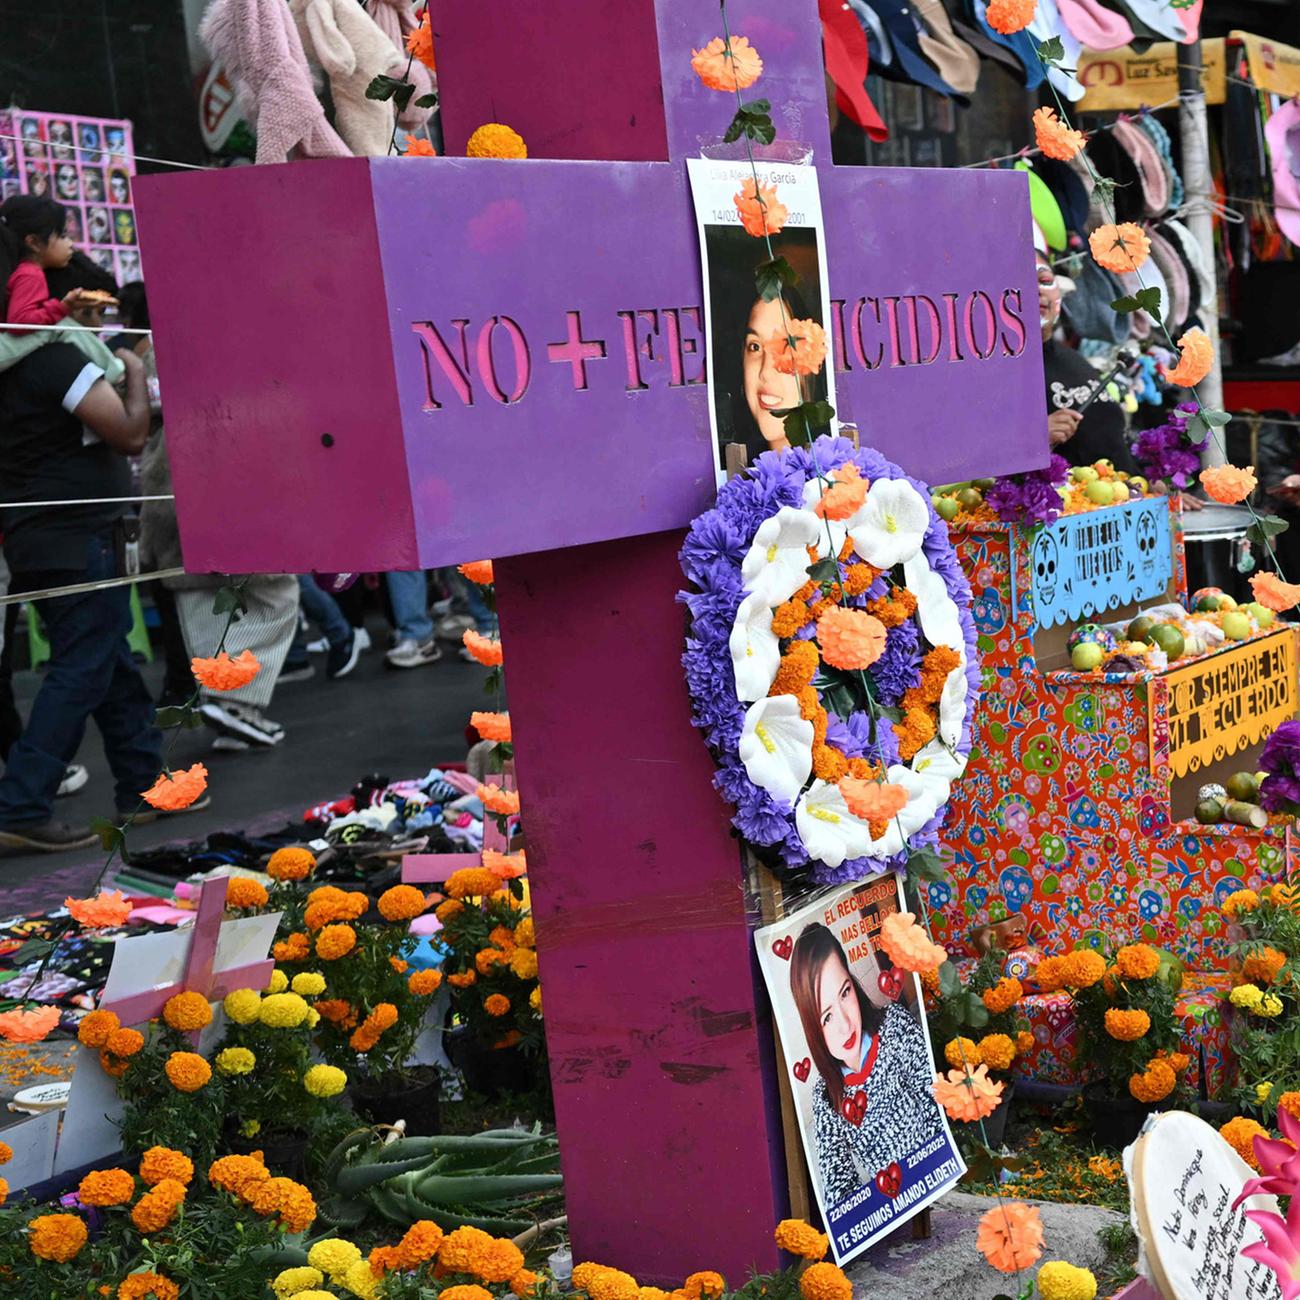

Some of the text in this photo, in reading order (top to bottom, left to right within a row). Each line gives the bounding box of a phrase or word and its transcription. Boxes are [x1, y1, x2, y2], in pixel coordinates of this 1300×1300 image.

[411, 314, 532, 412] NO
[617, 288, 1027, 393] FEICIDIOS
[1167, 643, 1287, 718] POR SIEMPRE EN
[1200, 676, 1289, 739] RECUERDO
[824, 879, 897, 926] EL RECUERDO
[841, 923, 859, 944] MAS
[848, 942, 868, 964] MAS
[907, 1135, 946, 1168] 22/06/2025
[829, 1186, 872, 1222] 22/06/2020
[837, 1158, 960, 1251] TE SEGUIMOS AMANDO ELIDETH
